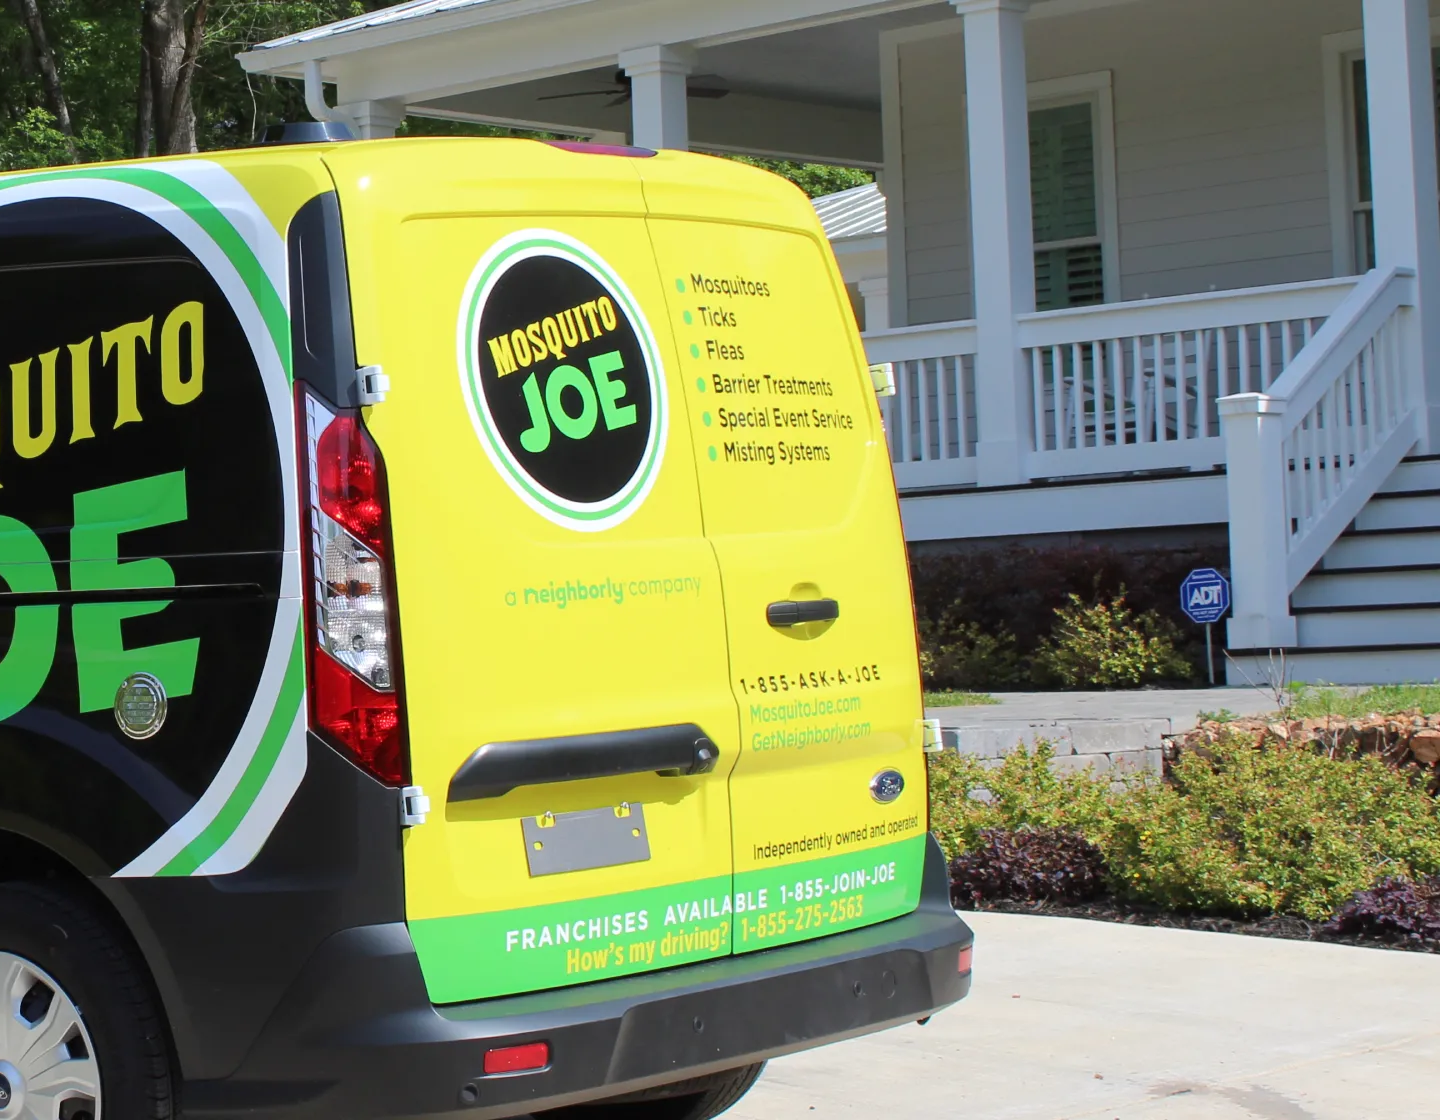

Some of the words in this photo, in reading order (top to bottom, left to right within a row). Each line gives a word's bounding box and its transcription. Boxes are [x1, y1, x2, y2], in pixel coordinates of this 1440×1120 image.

[690, 273, 771, 298] Mosquitoes
[697, 306, 737, 328] Ticks
[487, 295, 617, 378] MOSQUITO
[705, 339, 745, 361] Fleas
[713, 373, 760, 395] Barrier
[764, 375, 833, 397] Treatments
[519, 350, 637, 453] JOE
[719, 407, 770, 432] Special
[774, 408, 810, 429] Event
[812, 410, 853, 430] Service
[724, 441, 775, 466] Misting
[779, 441, 830, 466] Systems
[505, 590, 517, 606] a
[524, 577, 624, 609] neighborly
[628, 576, 701, 601] company
[1190, 585, 1221, 606] ADT
[740, 664, 881, 695] 1-855-ASK-A-JOE
[750, 696, 861, 725] MosquitoJoe.com
[752, 722, 871, 752] GetNeighborly.com
[753, 832, 833, 860] Independently
[836, 823, 867, 846] owned
[870, 820, 886, 838] and
[888, 813, 918, 837] operated
[506, 910, 649, 953] FRANCHISES
[663, 888, 768, 926] AVAILABLE
[779, 862, 896, 905] 1-855-JOIN-JOE
[566, 943, 624, 975] How's
[629, 940, 656, 970] my
[661, 921, 729, 957] driving?
[741, 895, 863, 942] 1-855-275-2563
